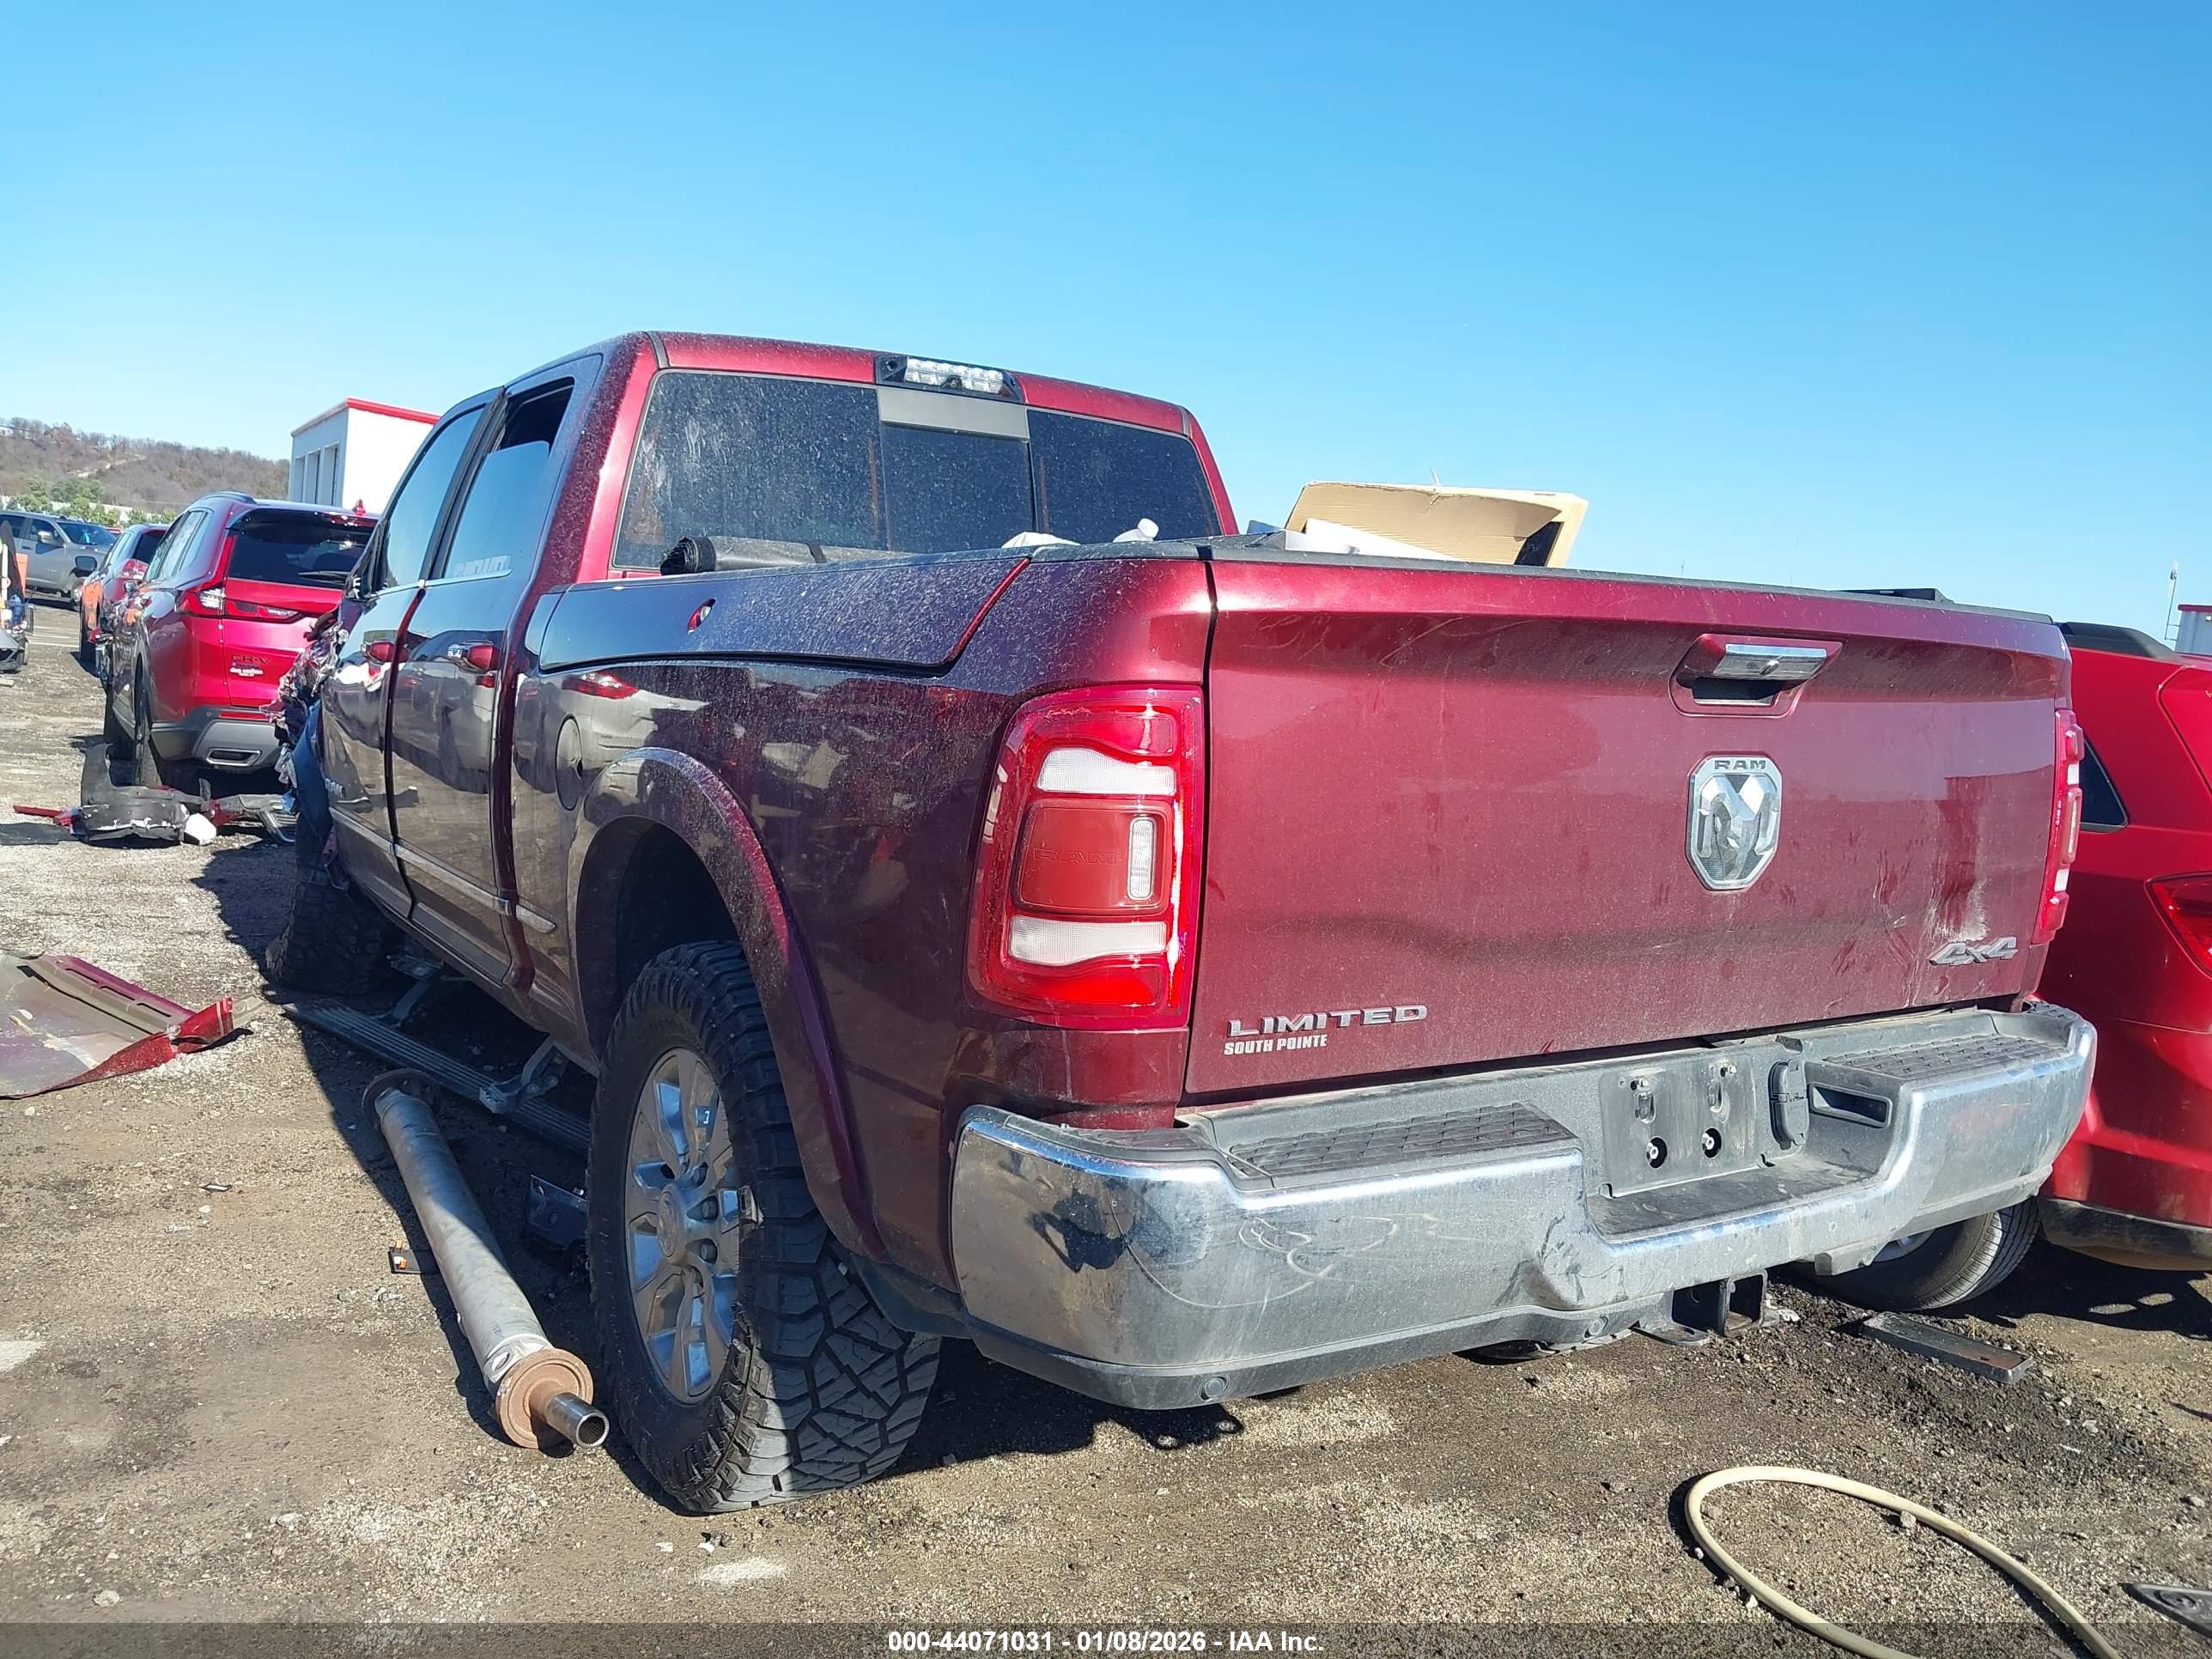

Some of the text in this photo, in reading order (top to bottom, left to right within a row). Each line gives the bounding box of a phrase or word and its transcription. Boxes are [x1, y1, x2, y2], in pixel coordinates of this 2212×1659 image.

[1714, 760, 1766, 770] RAM
[1033, 847, 1118, 866] RAM
[1227, 1003, 1429, 1037] LIMITED
[1223, 1034, 1328, 1056] SOUTH POINTE
